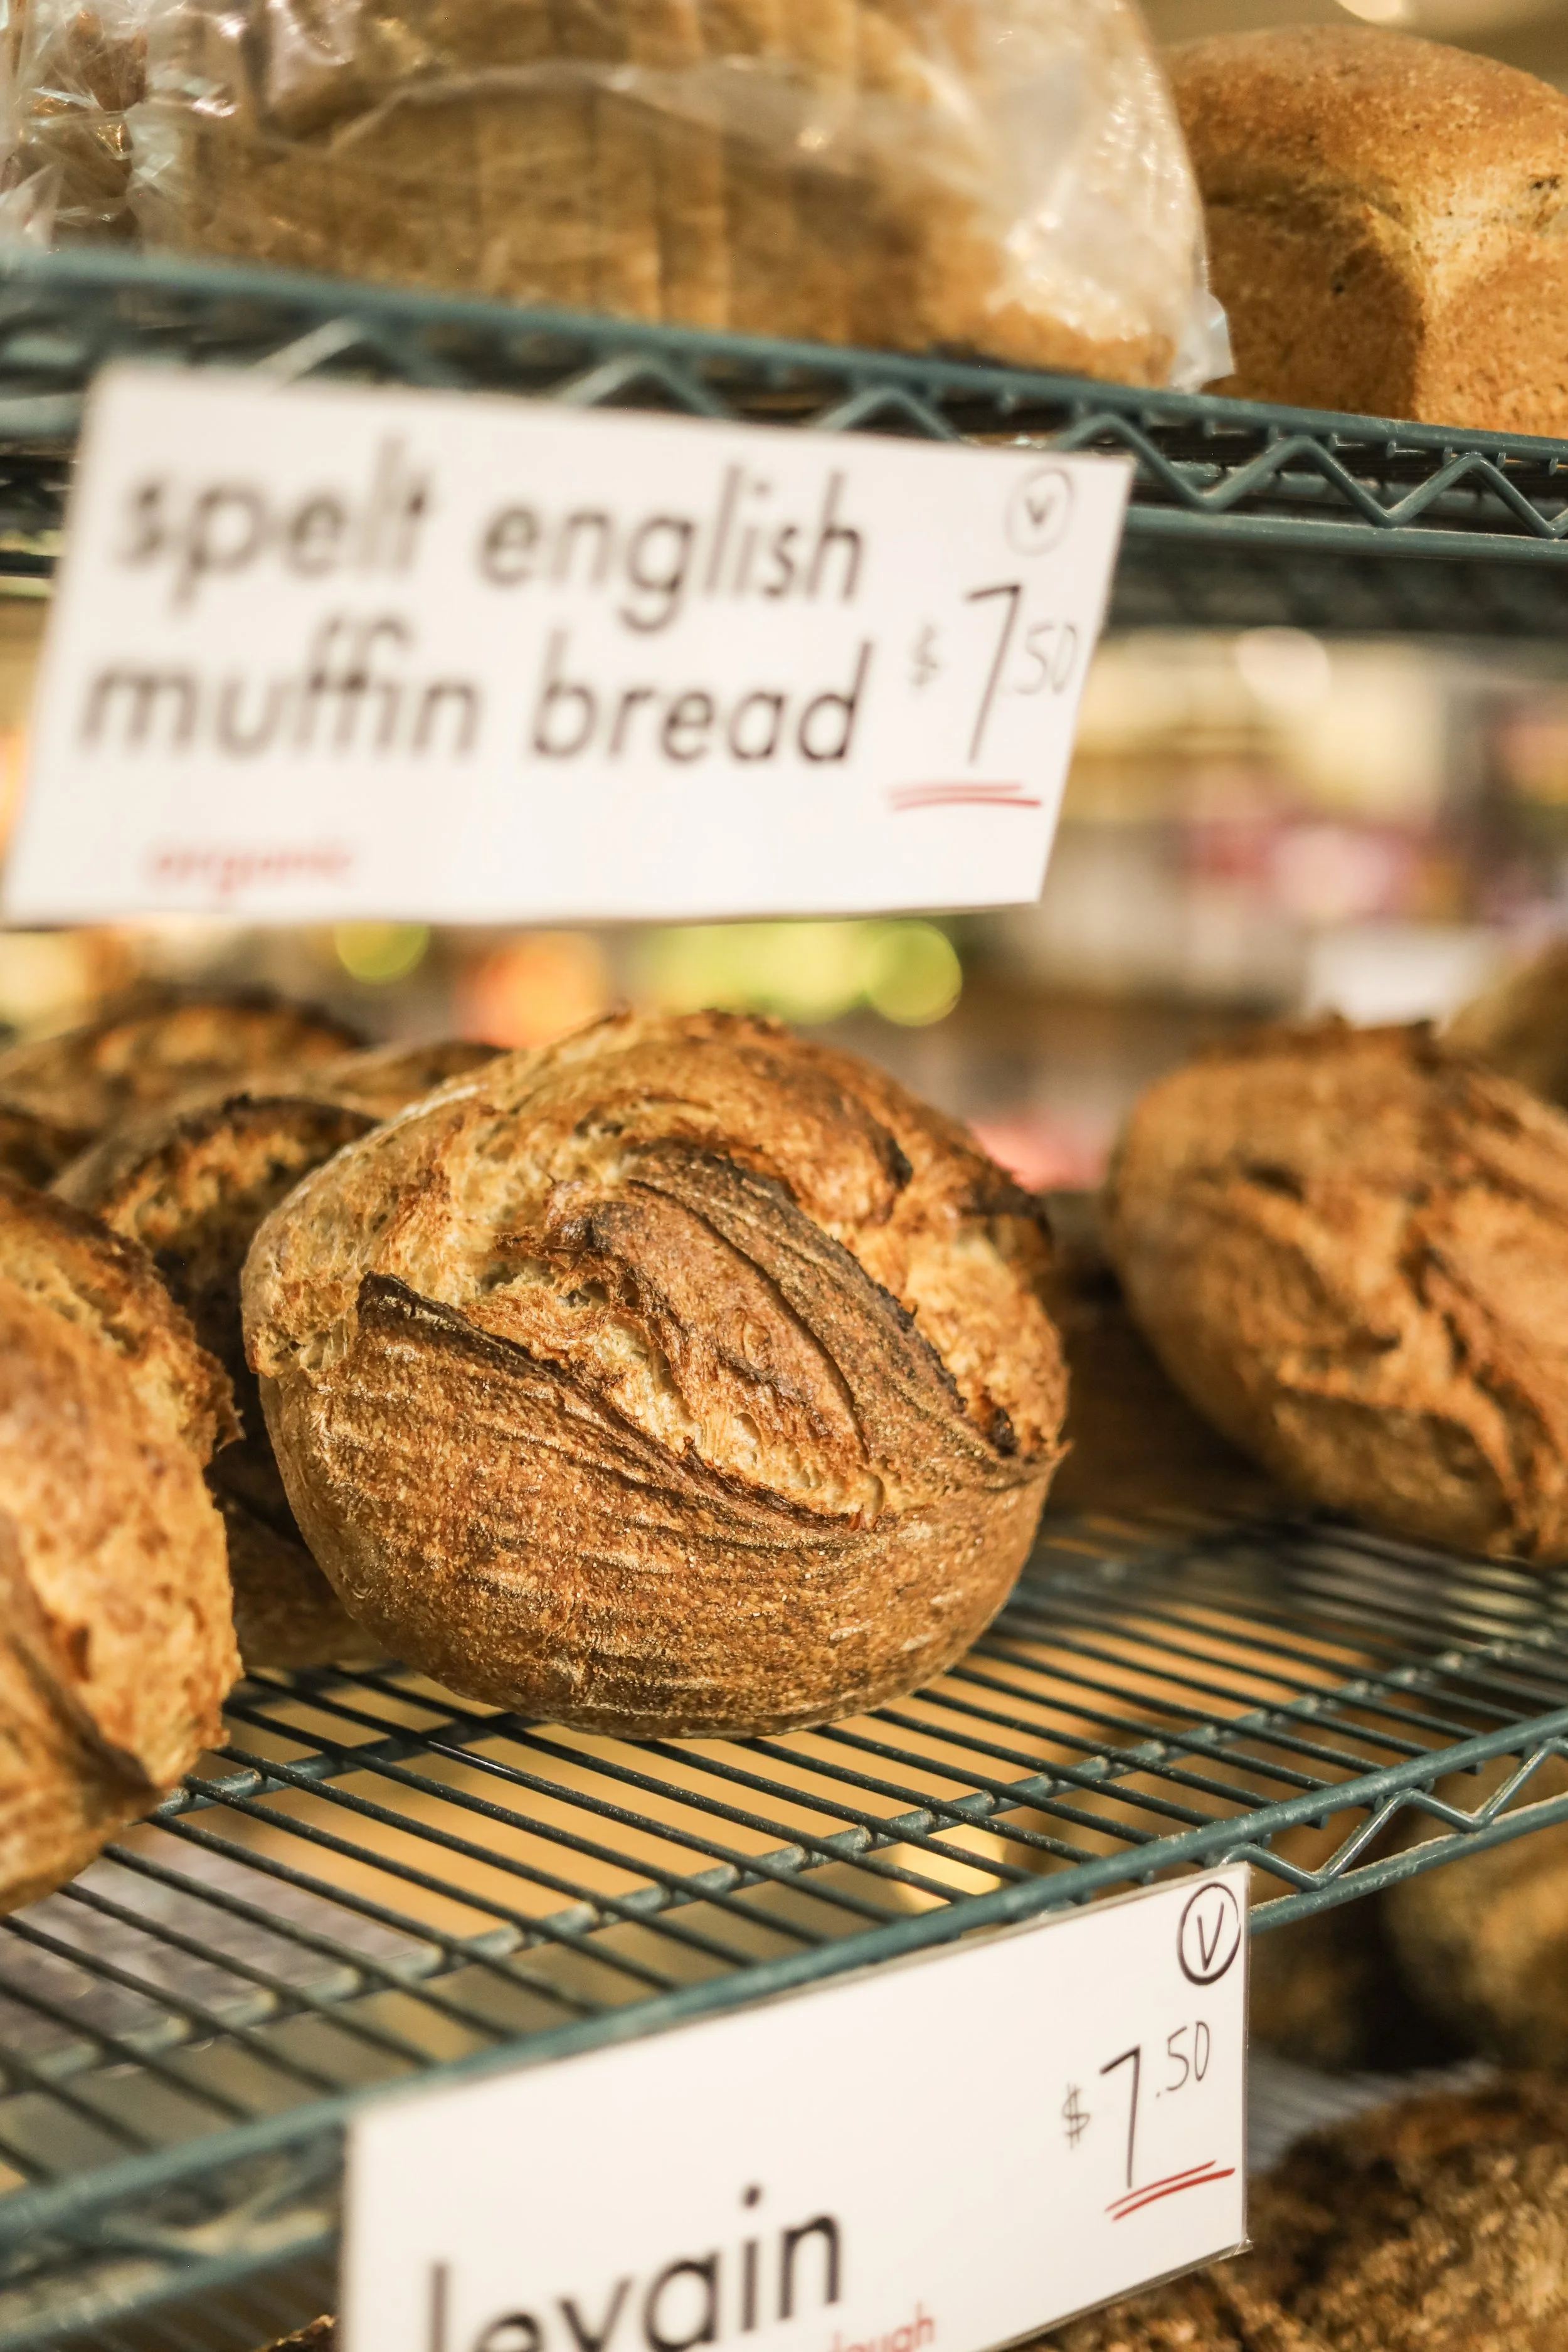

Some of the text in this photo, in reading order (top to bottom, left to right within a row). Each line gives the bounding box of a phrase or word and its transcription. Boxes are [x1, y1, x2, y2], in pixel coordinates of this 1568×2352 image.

[118, 433, 866, 637] spelt english
[78, 612, 874, 764] muffin bread
[428, 2183, 842, 2352] levain
